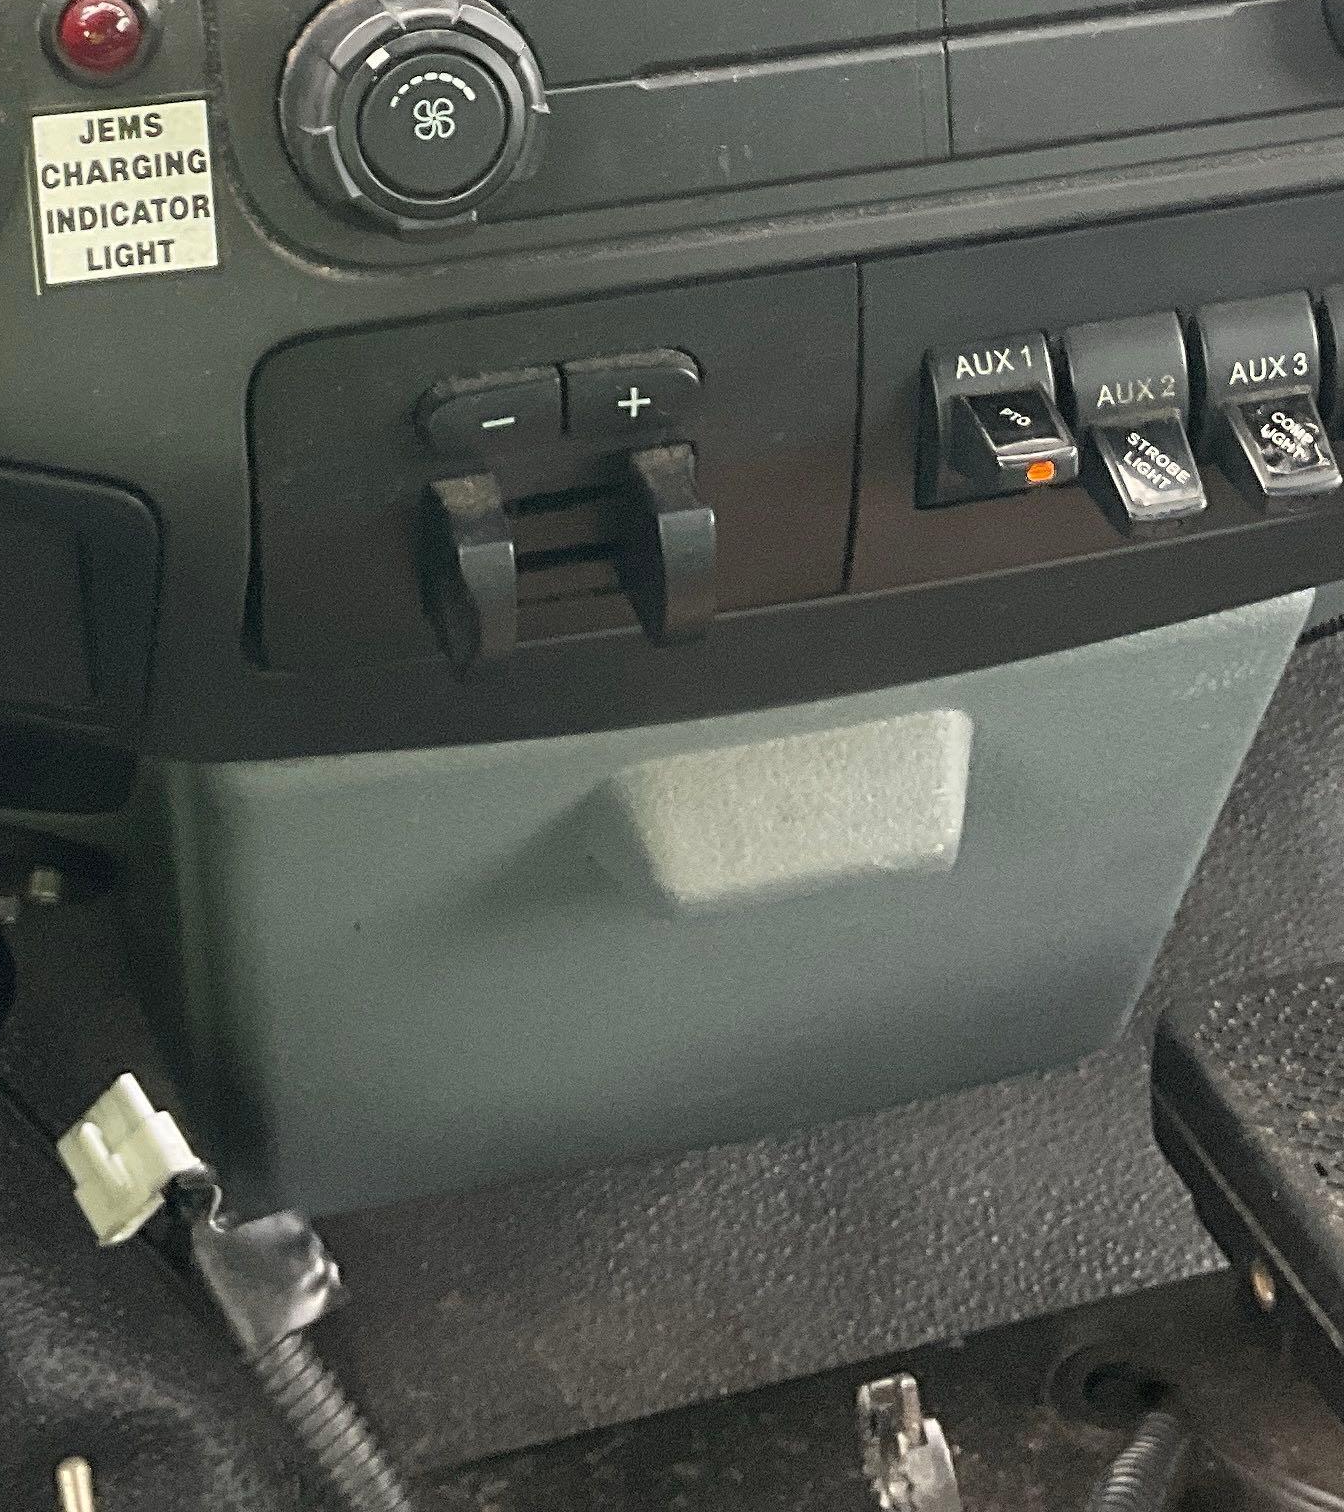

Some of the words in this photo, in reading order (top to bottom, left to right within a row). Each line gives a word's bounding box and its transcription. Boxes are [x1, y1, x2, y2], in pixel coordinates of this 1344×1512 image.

[78, 112, 165, 145] JEMS
[40, 147, 209, 191] CHARGING
[45, 194, 212, 236] INDICATOR
[84, 238, 175, 273] LIGHT
[955, 348, 1015, 380] AUX
[1019, 344, 1034, 368] 1
[1228, 353, 1289, 386] AUX
[1293, 351, 1309, 377] 3
[1096, 376, 1156, 408] AUX
[1160, 374, 1177, 398] 2
[998, 406, 1032, 428] PTO
[1270, 411, 1314, 445] COMP
[1122, 450, 1172, 491] LIGHT
[1126, 431, 1192, 485] STROBE
